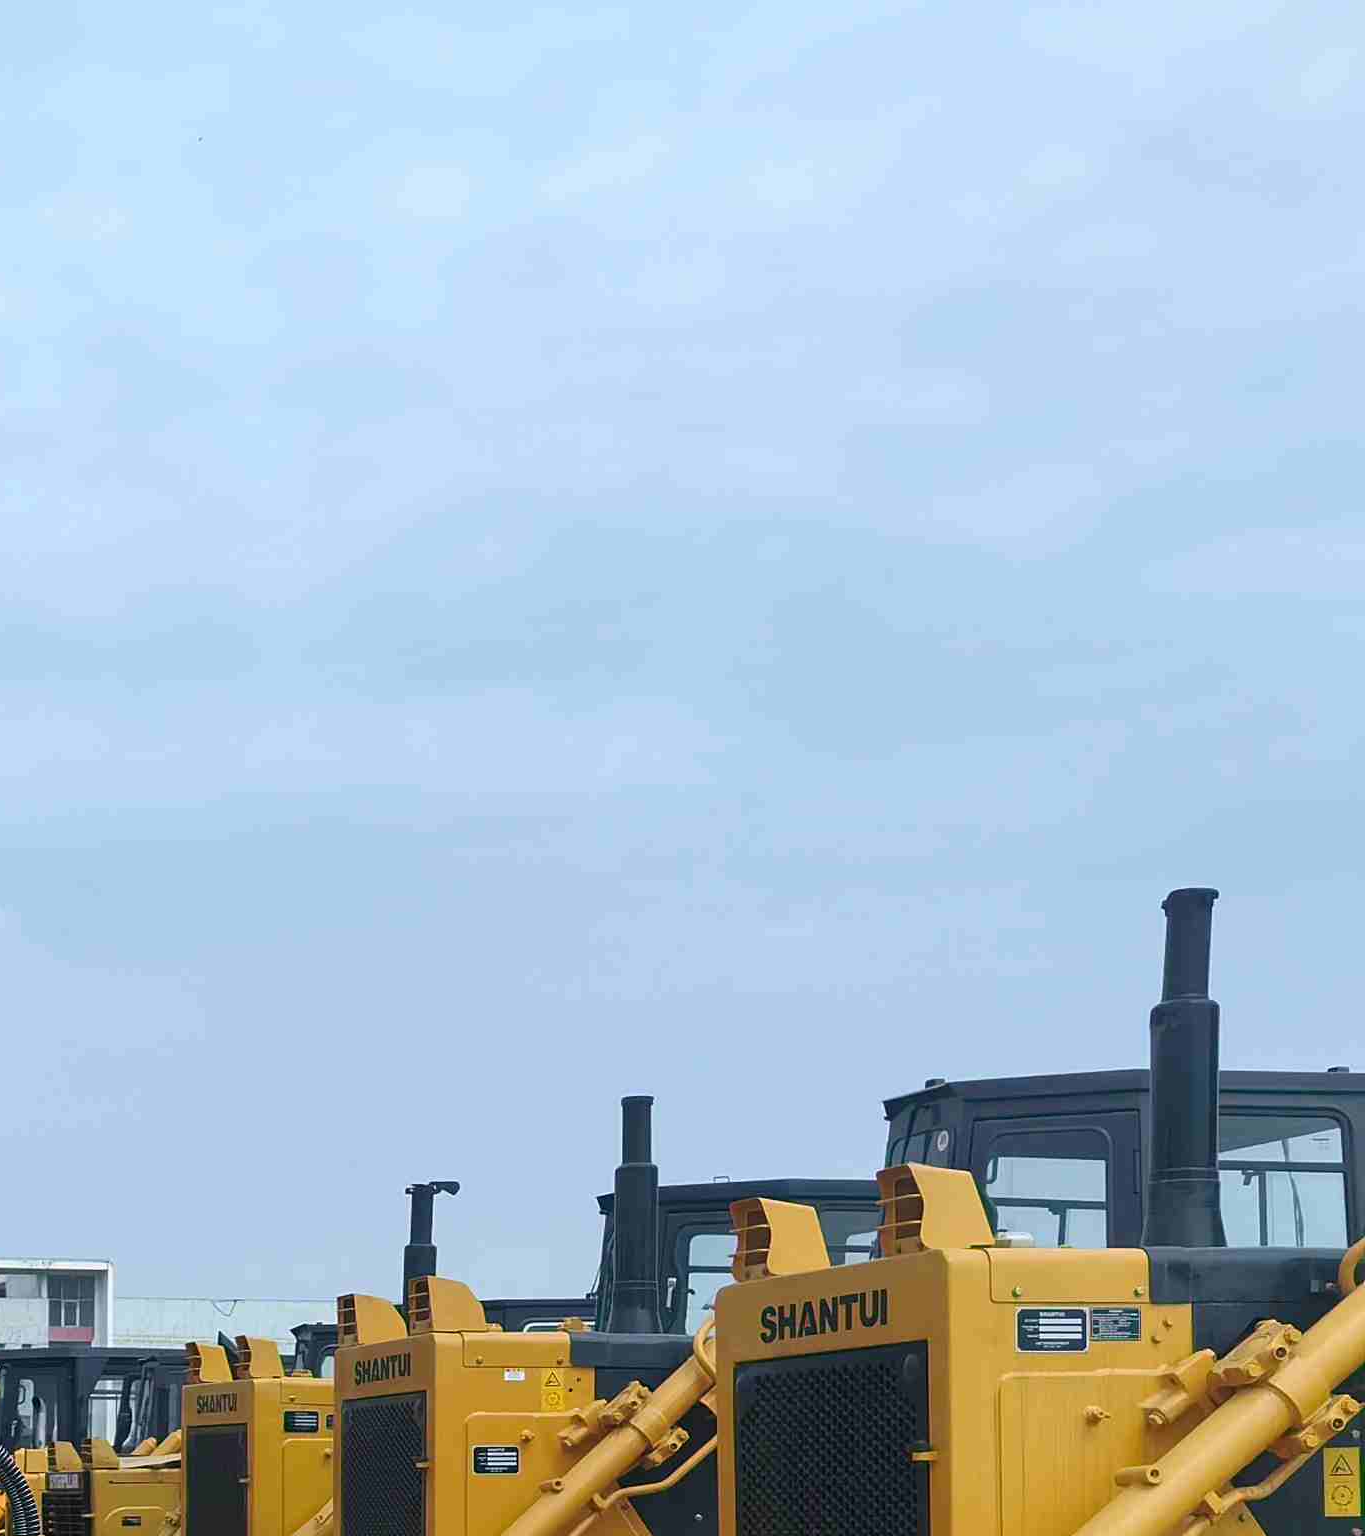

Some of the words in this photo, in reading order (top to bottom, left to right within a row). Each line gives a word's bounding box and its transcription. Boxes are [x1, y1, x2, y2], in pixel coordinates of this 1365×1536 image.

[759, 1287, 888, 1344] SHANTUI
[355, 1352, 411, 1386] SHANTUI
[196, 1392, 238, 1414] SHANTUI
